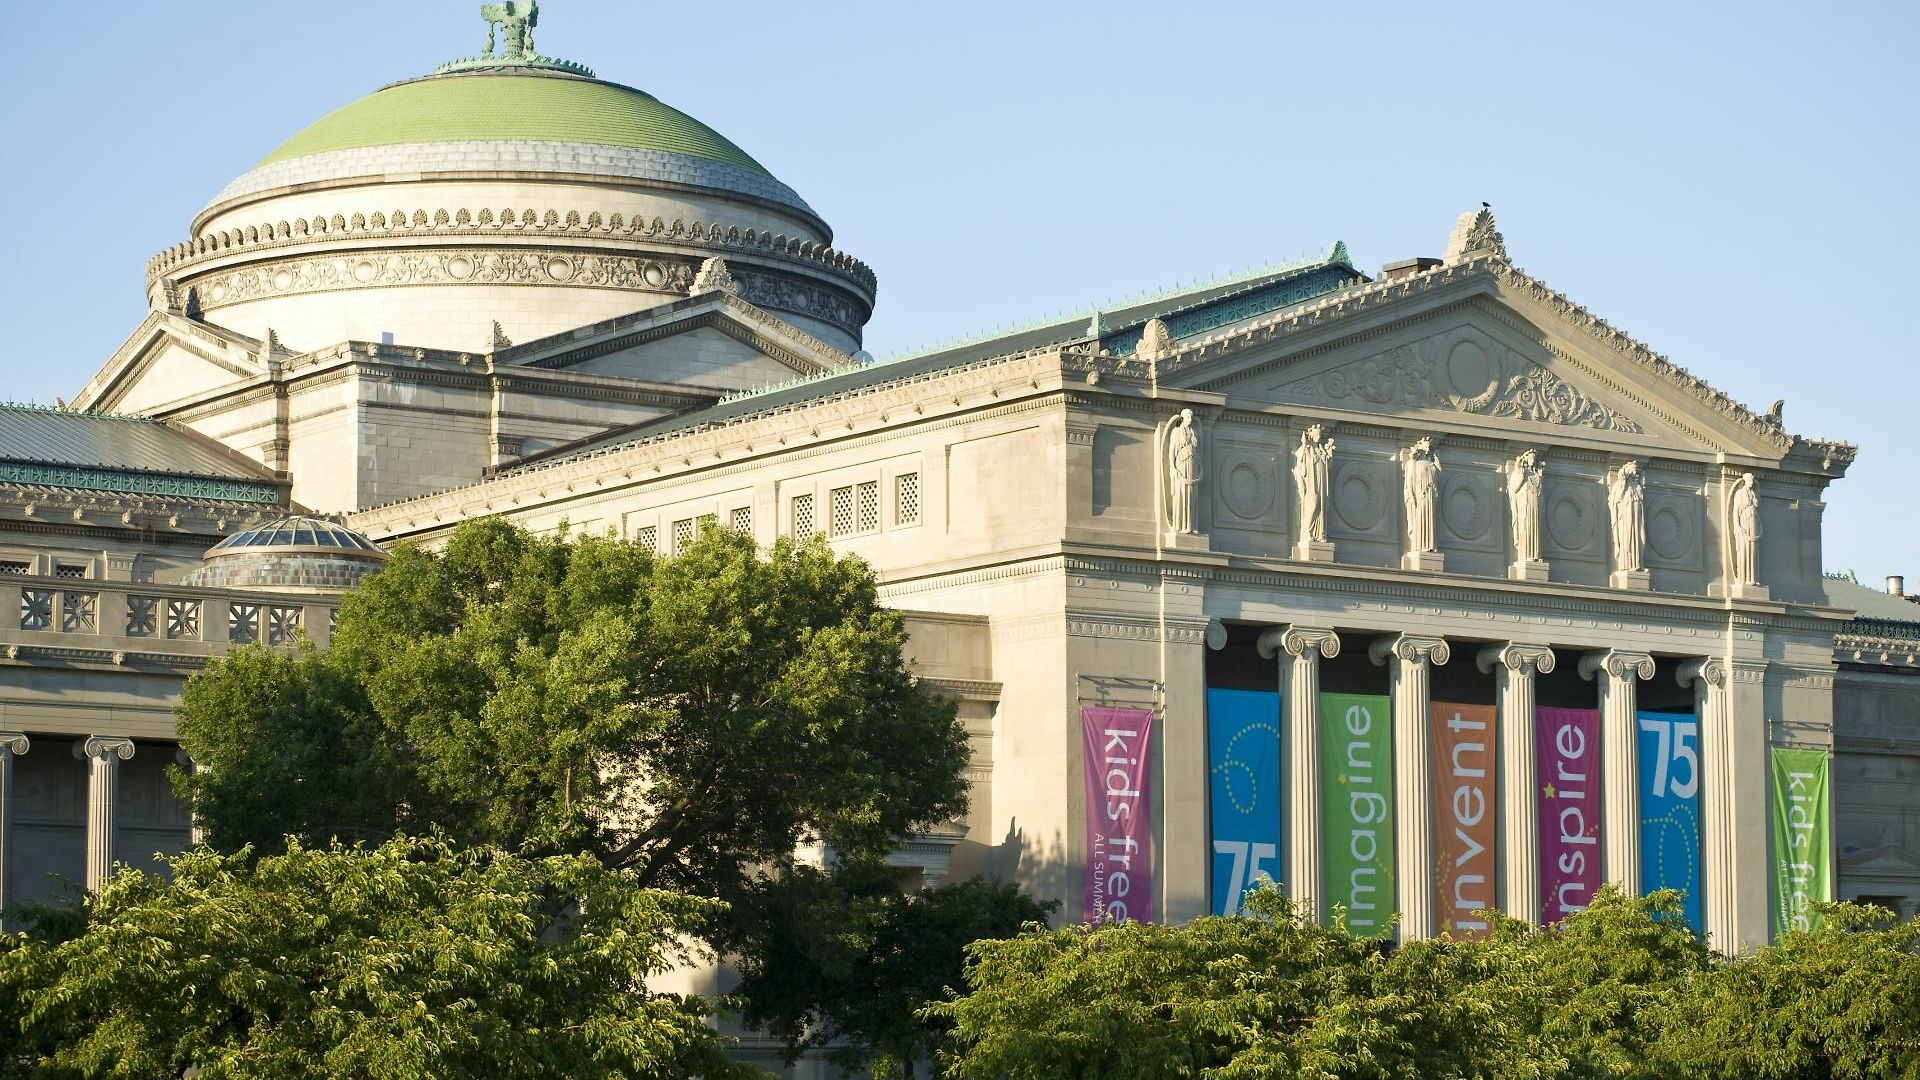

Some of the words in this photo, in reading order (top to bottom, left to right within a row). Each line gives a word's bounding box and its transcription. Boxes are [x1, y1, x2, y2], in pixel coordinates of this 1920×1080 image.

[1104, 729, 1140, 821] kids
[1638, 719, 1698, 799] 75
[1094, 832, 1105, 859] ALL
[1340, 704, 1387, 926] imagine
[1444, 712, 1488, 931] invent
[1549, 724, 1597, 929] nspire
[1788, 771, 1815, 848] kids
[1106, 835, 1138, 924] free
